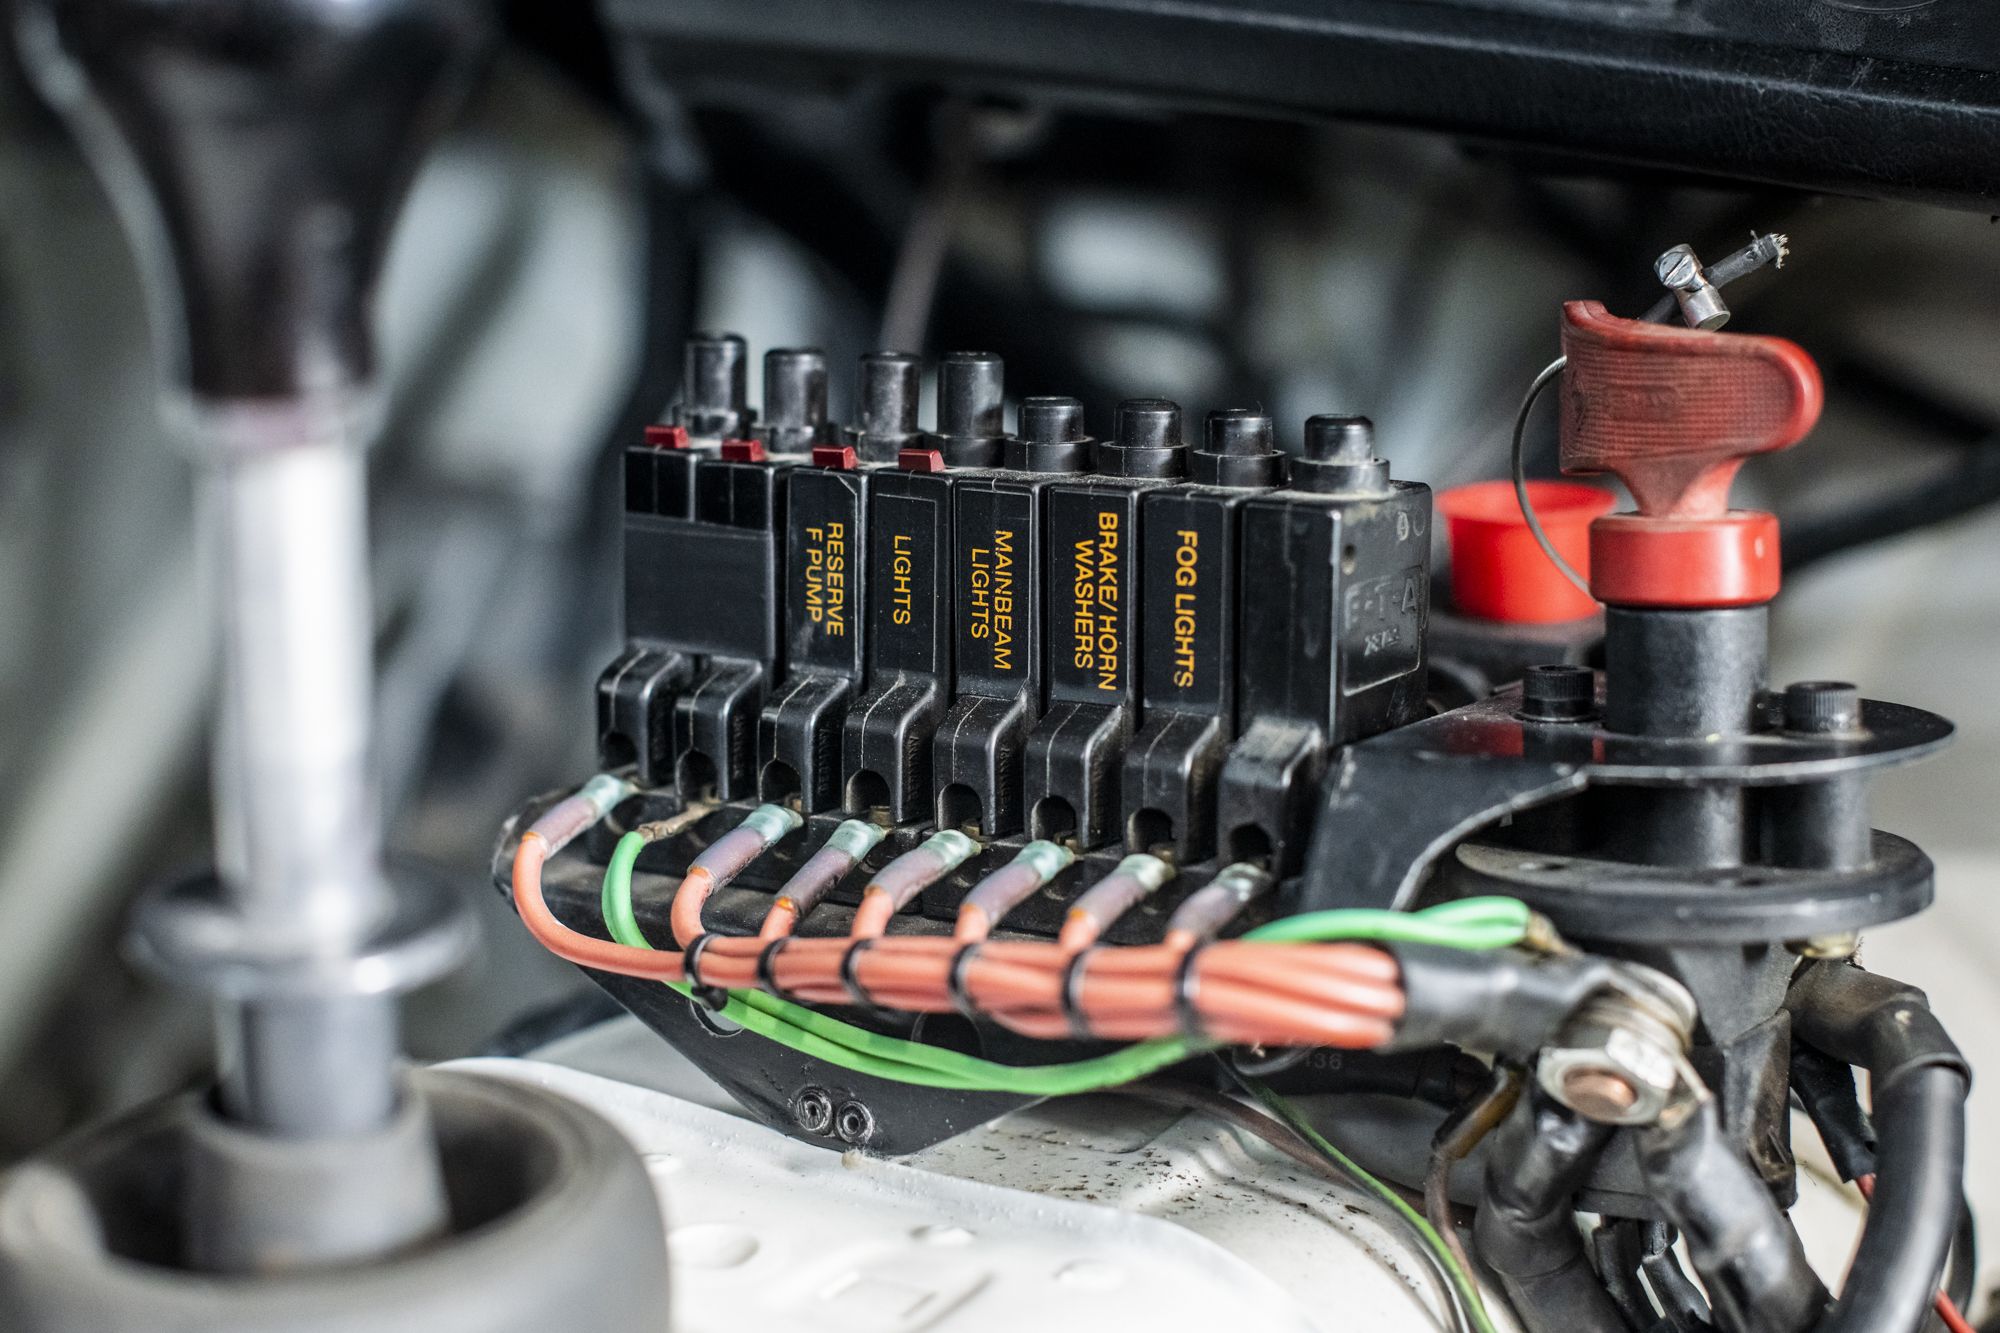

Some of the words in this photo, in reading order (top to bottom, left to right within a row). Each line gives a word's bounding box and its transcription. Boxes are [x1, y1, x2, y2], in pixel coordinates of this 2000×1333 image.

[806, 527, 823, 543] F
[826, 522, 845, 637] RESERVE
[893, 534, 912, 626] LIGHTS
[1175, 529, 1199, 587] FOG
[806, 548, 823, 624] PUMP
[971, 548, 990, 639] LIGHTS
[994, 529, 1015, 670] MAINBEAM
[1074, 539, 1095, 670] WASHERS
[1098, 511, 1119, 692] BRAKE/HORN
[1175, 593, 1198, 689] LIGHTS
